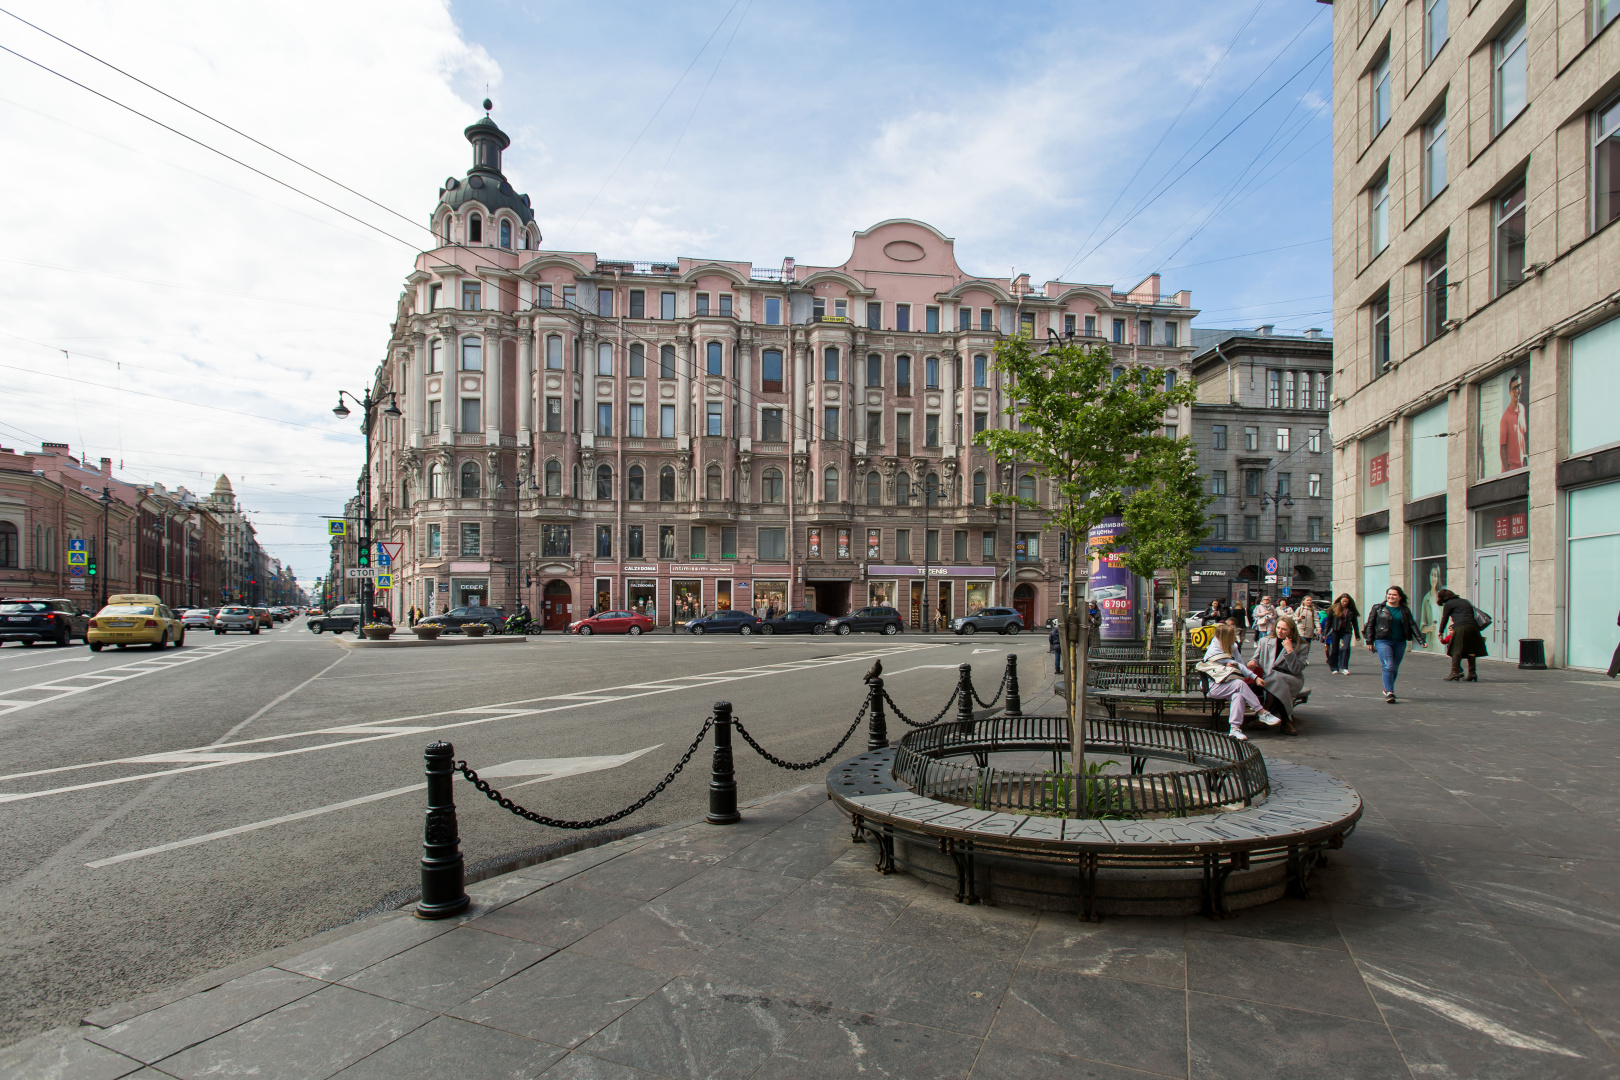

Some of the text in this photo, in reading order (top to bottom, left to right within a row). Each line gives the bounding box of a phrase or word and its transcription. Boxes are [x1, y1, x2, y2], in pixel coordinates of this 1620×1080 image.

[1512, 516, 1523, 525] UNI
[1512, 526, 1524, 536] QLO
[350, 569, 375, 577] СТОП
[1111, 600, 1126, 608] 790
